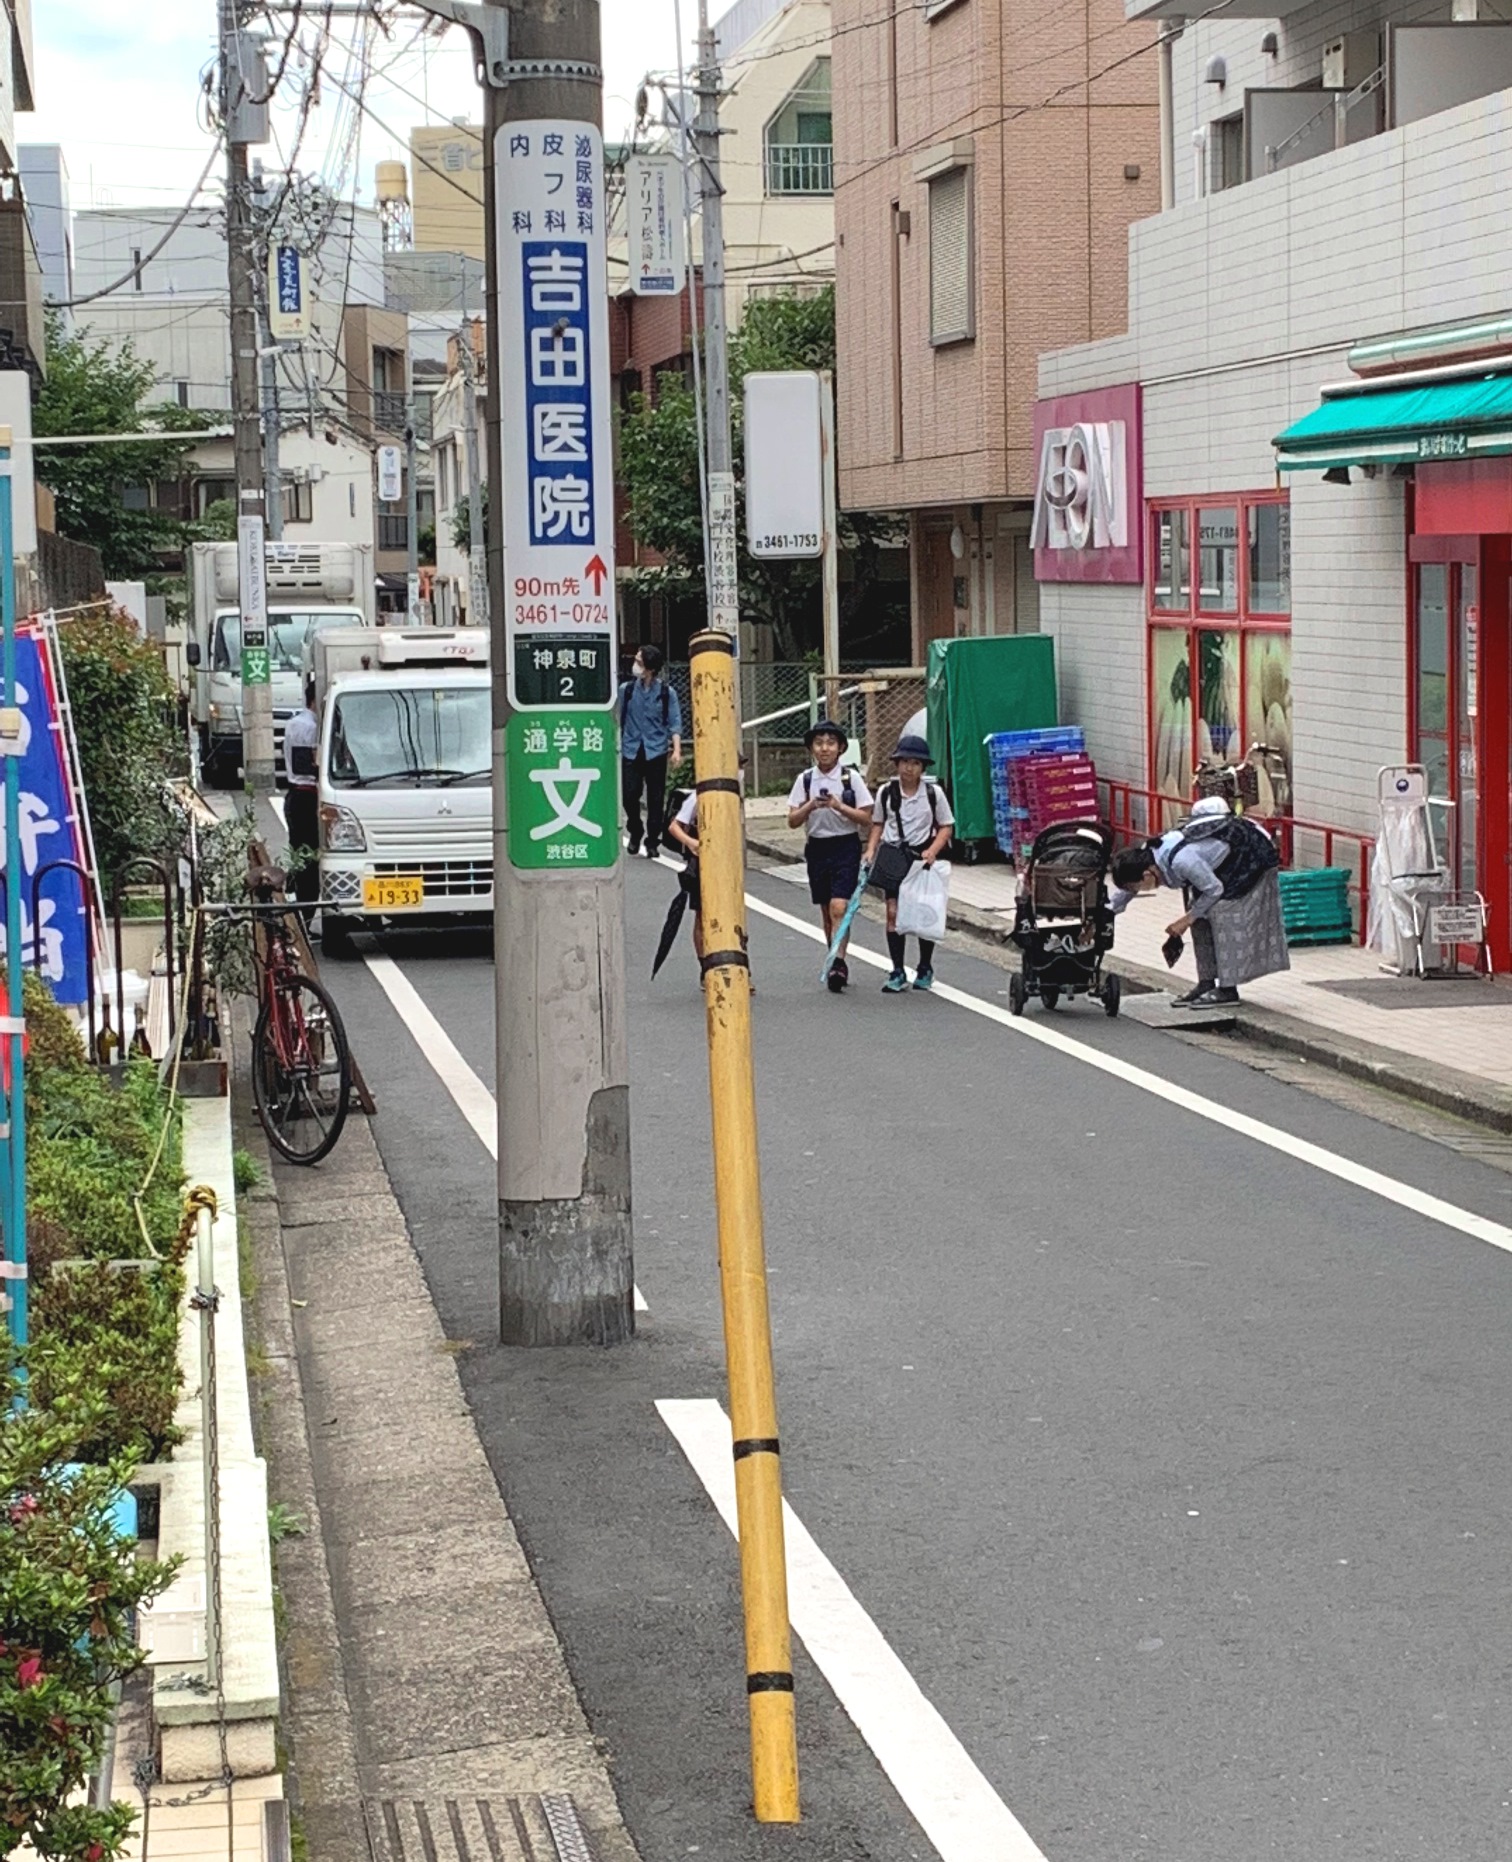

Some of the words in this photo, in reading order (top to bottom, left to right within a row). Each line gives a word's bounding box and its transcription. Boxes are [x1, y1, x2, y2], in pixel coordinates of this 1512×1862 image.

[510, 133, 532, 235] 内科
[543, 132, 566, 234] 皮フ科
[575, 134, 593, 235] 泌尿器科
[527, 248, 591, 538] 吉田医院
[764, 534, 818, 548] 3461-1753
[515, 577, 580, 597] 90m先
[515, 604, 609, 625] 3461-0724
[533, 648, 597, 670] 神泉町
[559, 677, 574, 697] 2
[523, 727, 604, 754] 通学路
[529, 757, 603, 841] 文
[546, 844, 589, 860] 渋谷区
